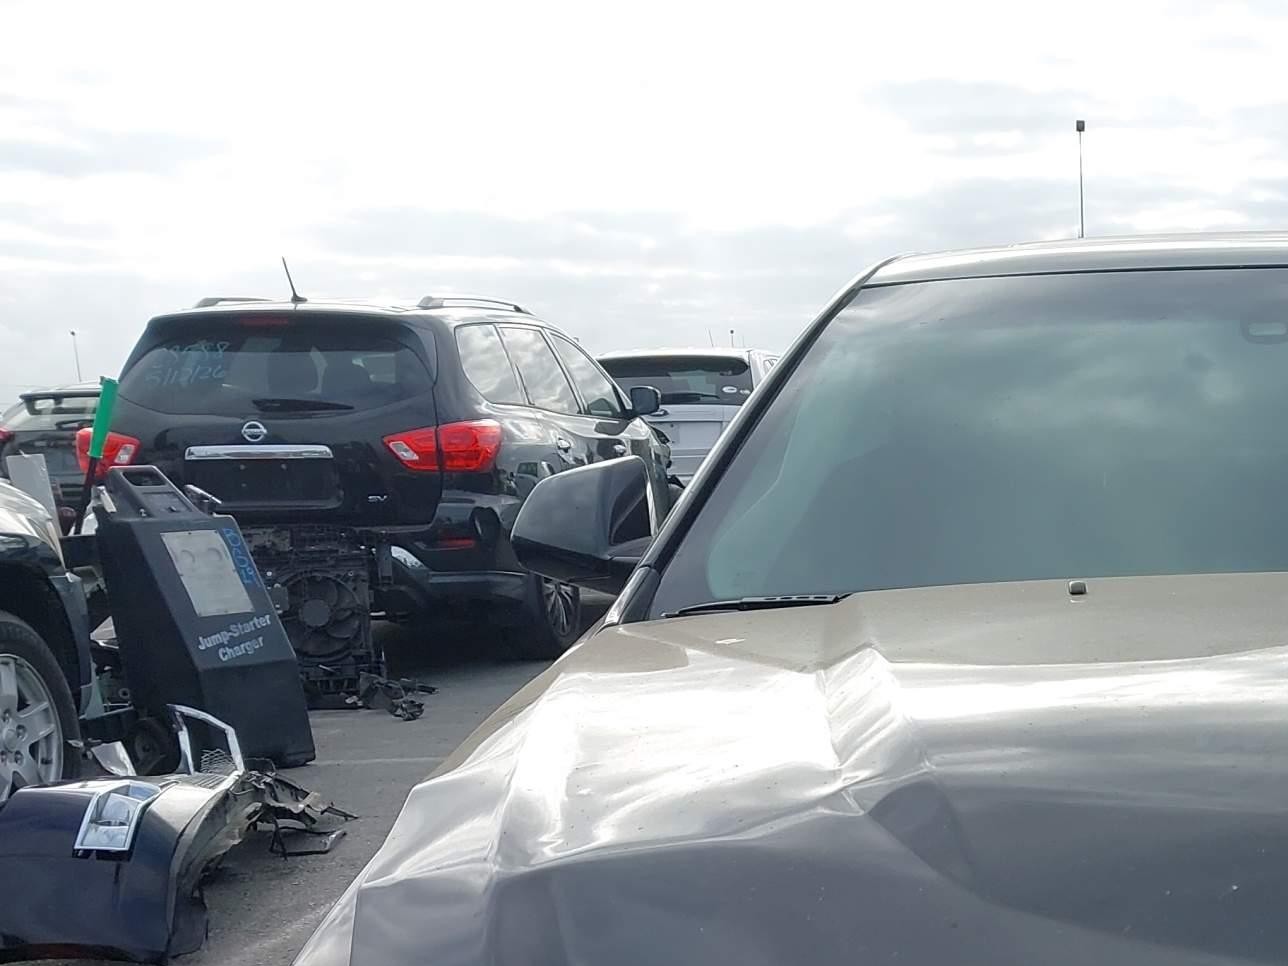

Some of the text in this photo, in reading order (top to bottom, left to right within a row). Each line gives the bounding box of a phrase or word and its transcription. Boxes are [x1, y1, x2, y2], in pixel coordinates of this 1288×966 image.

[367, 494, 388, 503] SV
[198, 614, 272, 651] Jump-Starter
[218, 636, 265, 662] Charger
